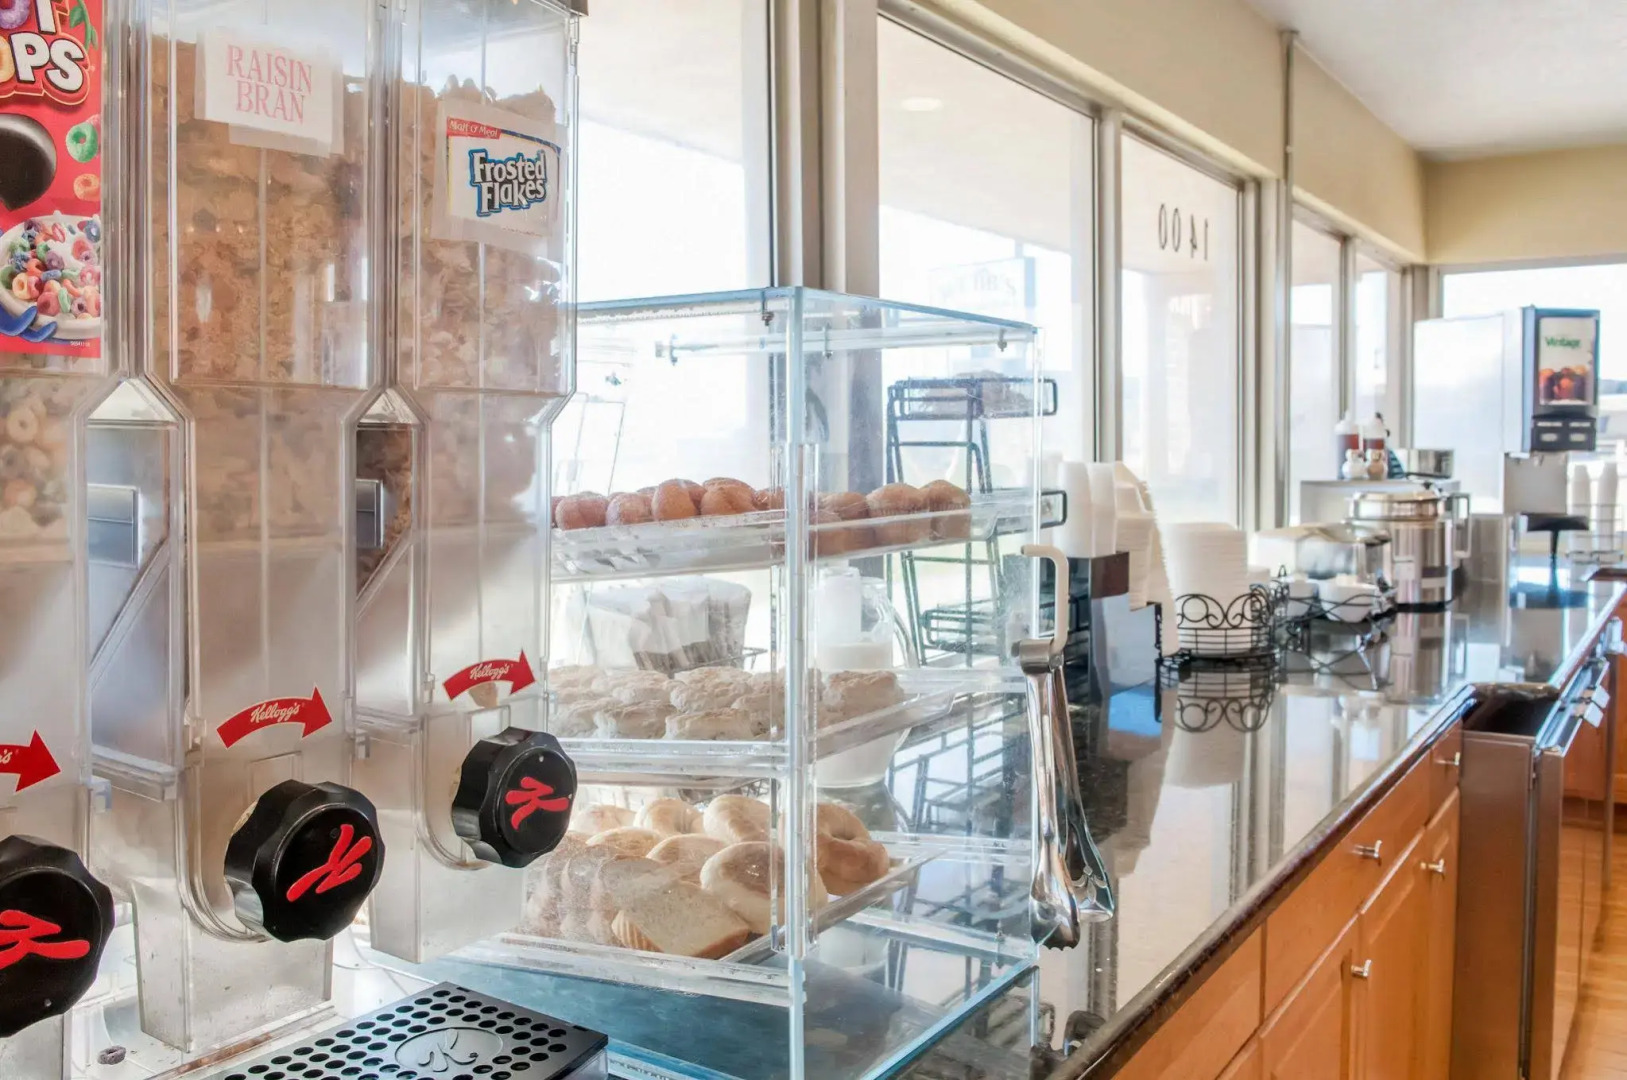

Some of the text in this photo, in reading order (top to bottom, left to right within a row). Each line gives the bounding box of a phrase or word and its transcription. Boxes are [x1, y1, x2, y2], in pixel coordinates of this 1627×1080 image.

[226, 44, 312, 95] RAISIN
[236, 80, 304, 123] BRAN
[470, 149, 546, 185] Frosted
[479, 179, 546, 215] Flakes
[469, 662, 511, 680] Kellogg's
[250, 702, 301, 723] Kellogg's
